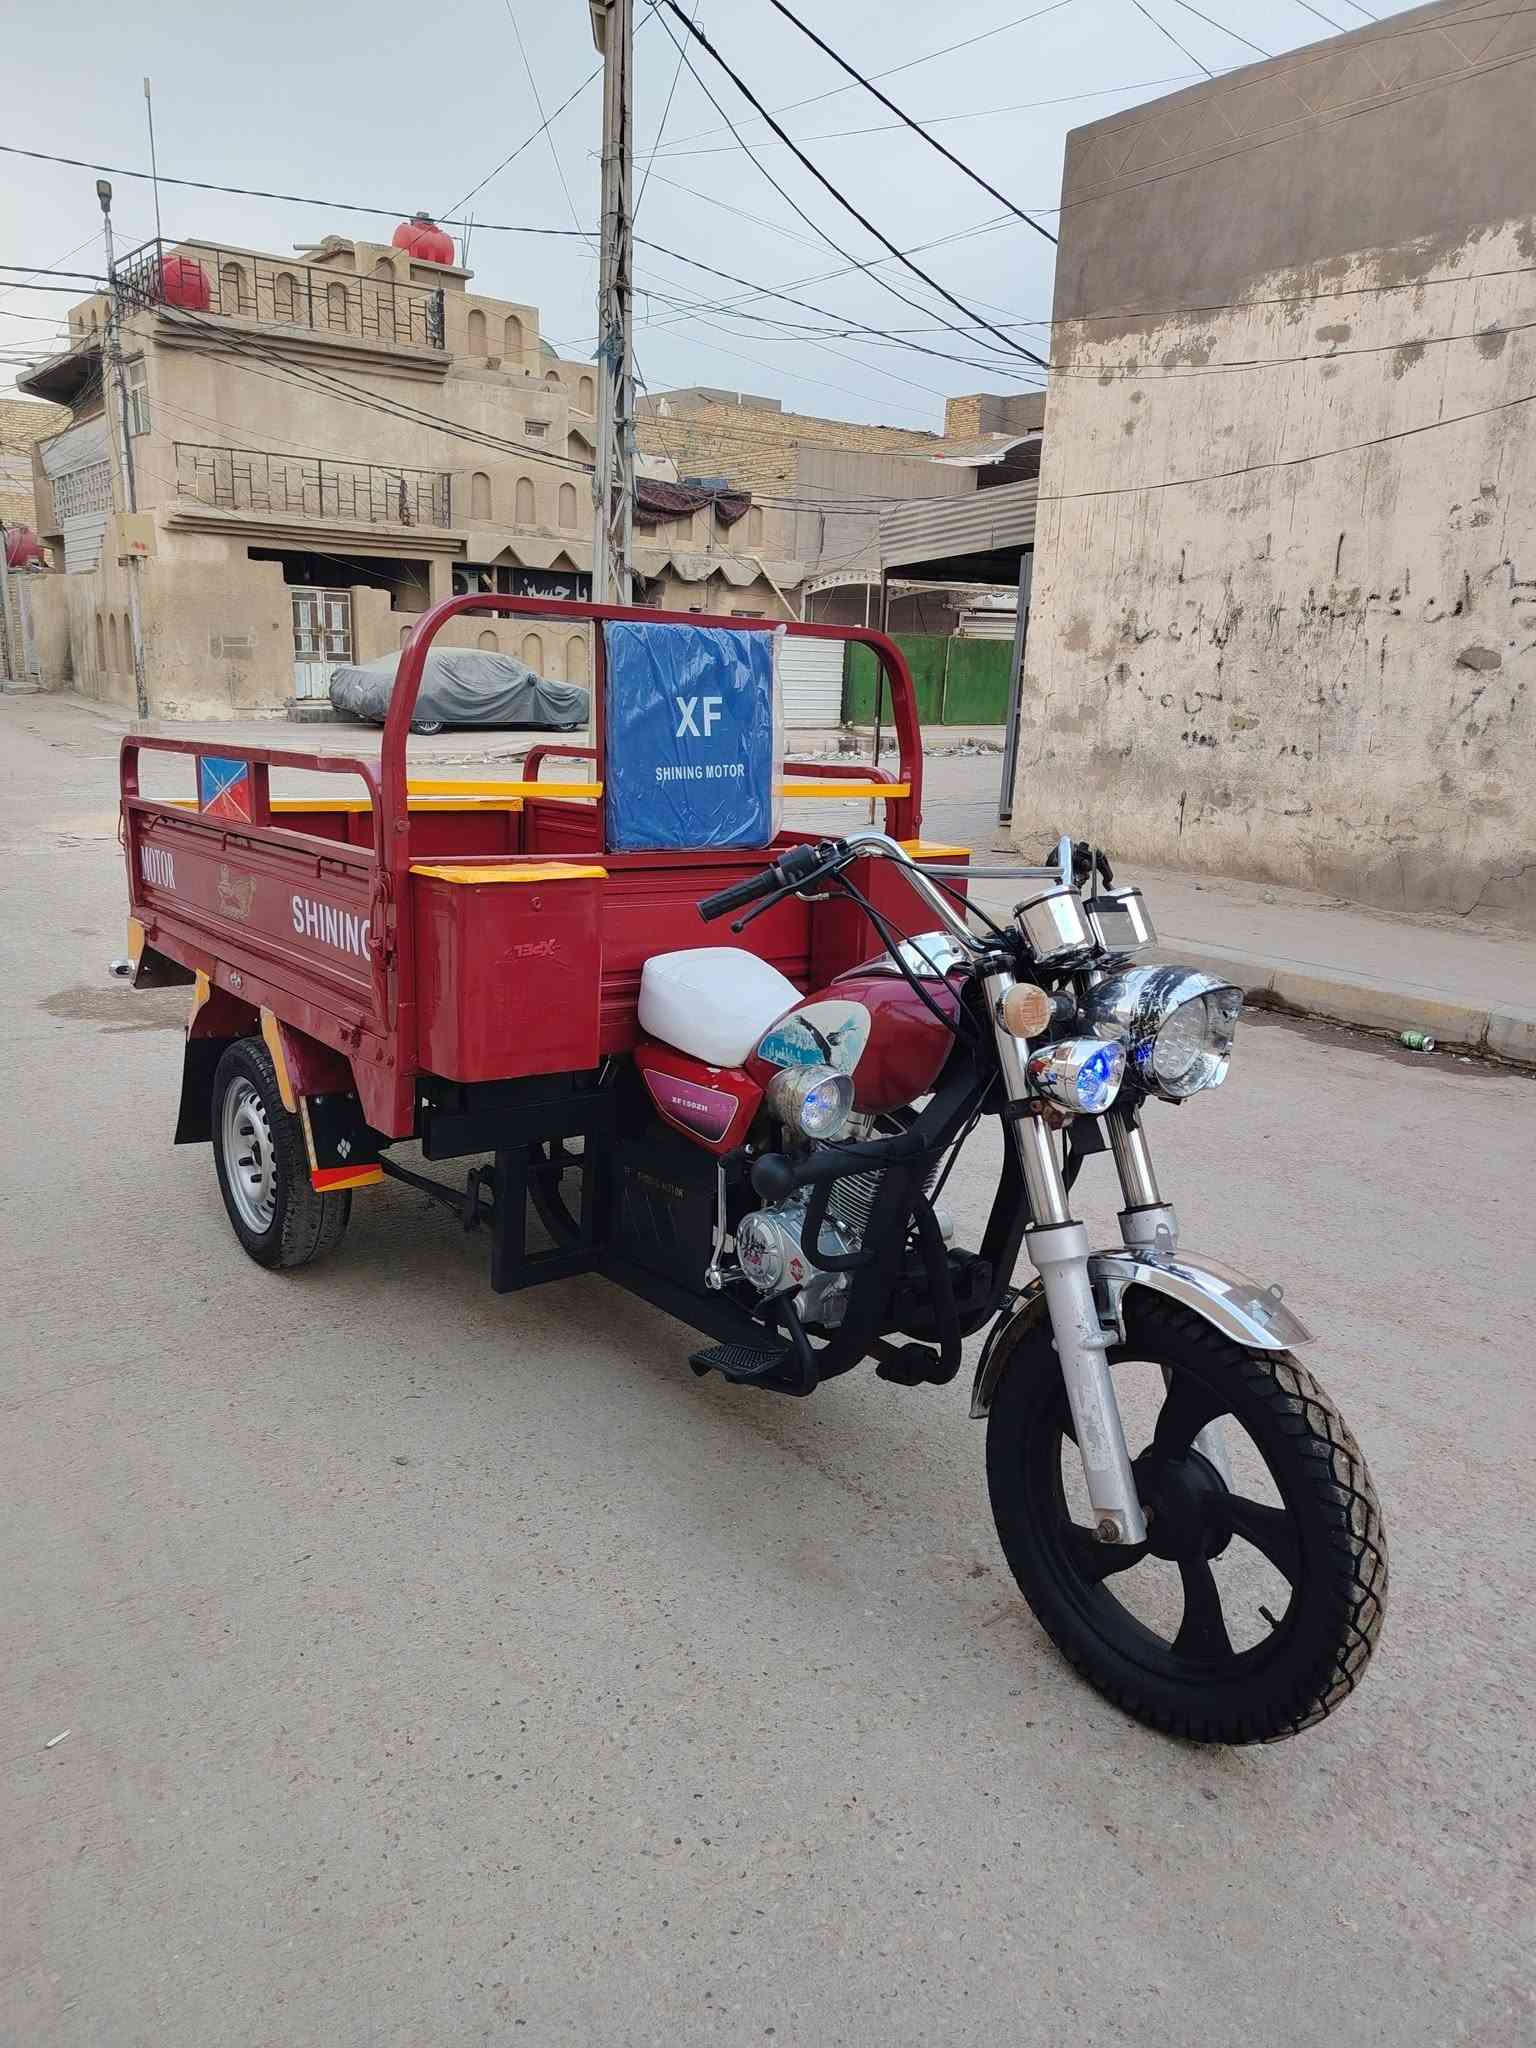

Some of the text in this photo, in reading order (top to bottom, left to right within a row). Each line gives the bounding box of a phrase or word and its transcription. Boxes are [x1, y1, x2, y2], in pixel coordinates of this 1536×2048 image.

[675, 696, 723, 737] XF
[655, 763, 745, 781] SHINING MOTOR
[140, 845, 176, 890] MOTOR
